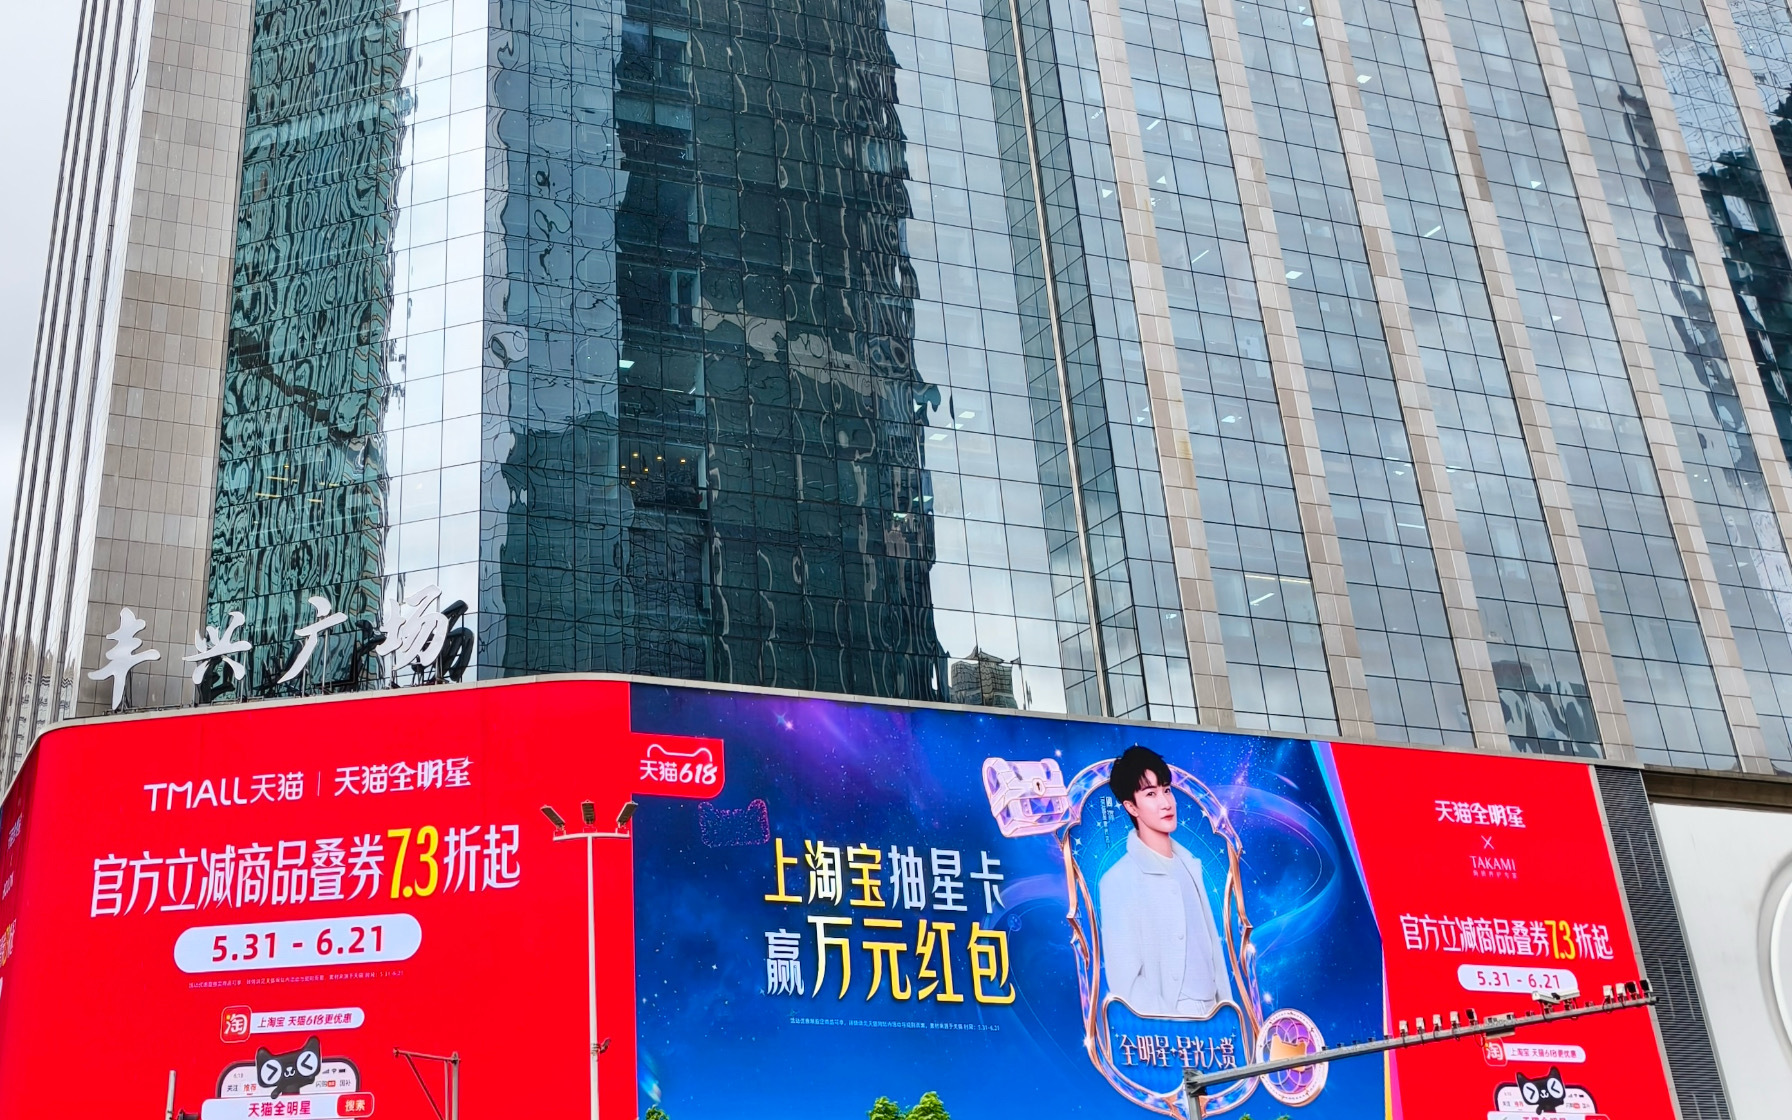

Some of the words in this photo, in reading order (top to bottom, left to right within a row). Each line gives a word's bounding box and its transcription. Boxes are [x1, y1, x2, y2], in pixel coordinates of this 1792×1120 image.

[88, 585, 450, 710] 丰兴广场
[334, 756, 474, 797] 天猫全明星
[640, 758, 719, 786] 天猫618
[1434, 799, 1526, 829] 天猫全明星
[90, 825, 521, 917] 官方立减商品叠券7.3折起
[764, 838, 1006, 914] 上淘宝抽星卡
[1469, 855, 1517, 872] TAKAMI
[212, 932, 276, 962] 5.31
[316, 925, 383, 956] 6.21
[1399, 913, 1615, 960] 官方立减商品叠券7.3折起
[764, 915, 1017, 1005] 赢万元红包
[1477, 970, 1510, 988] 5.31
[1528, 974, 1562, 990] 6.21
[224, 1012, 249, 1036] 淘
[257, 1016, 285, 1029] 上淘宝
[287, 1012, 353, 1027] 天猫618更优惠
[1485, 1041, 1505, 1061] 淘
[248, 1100, 312, 1117] 天猫全明星
[344, 1099, 366, 1112] 搜索
